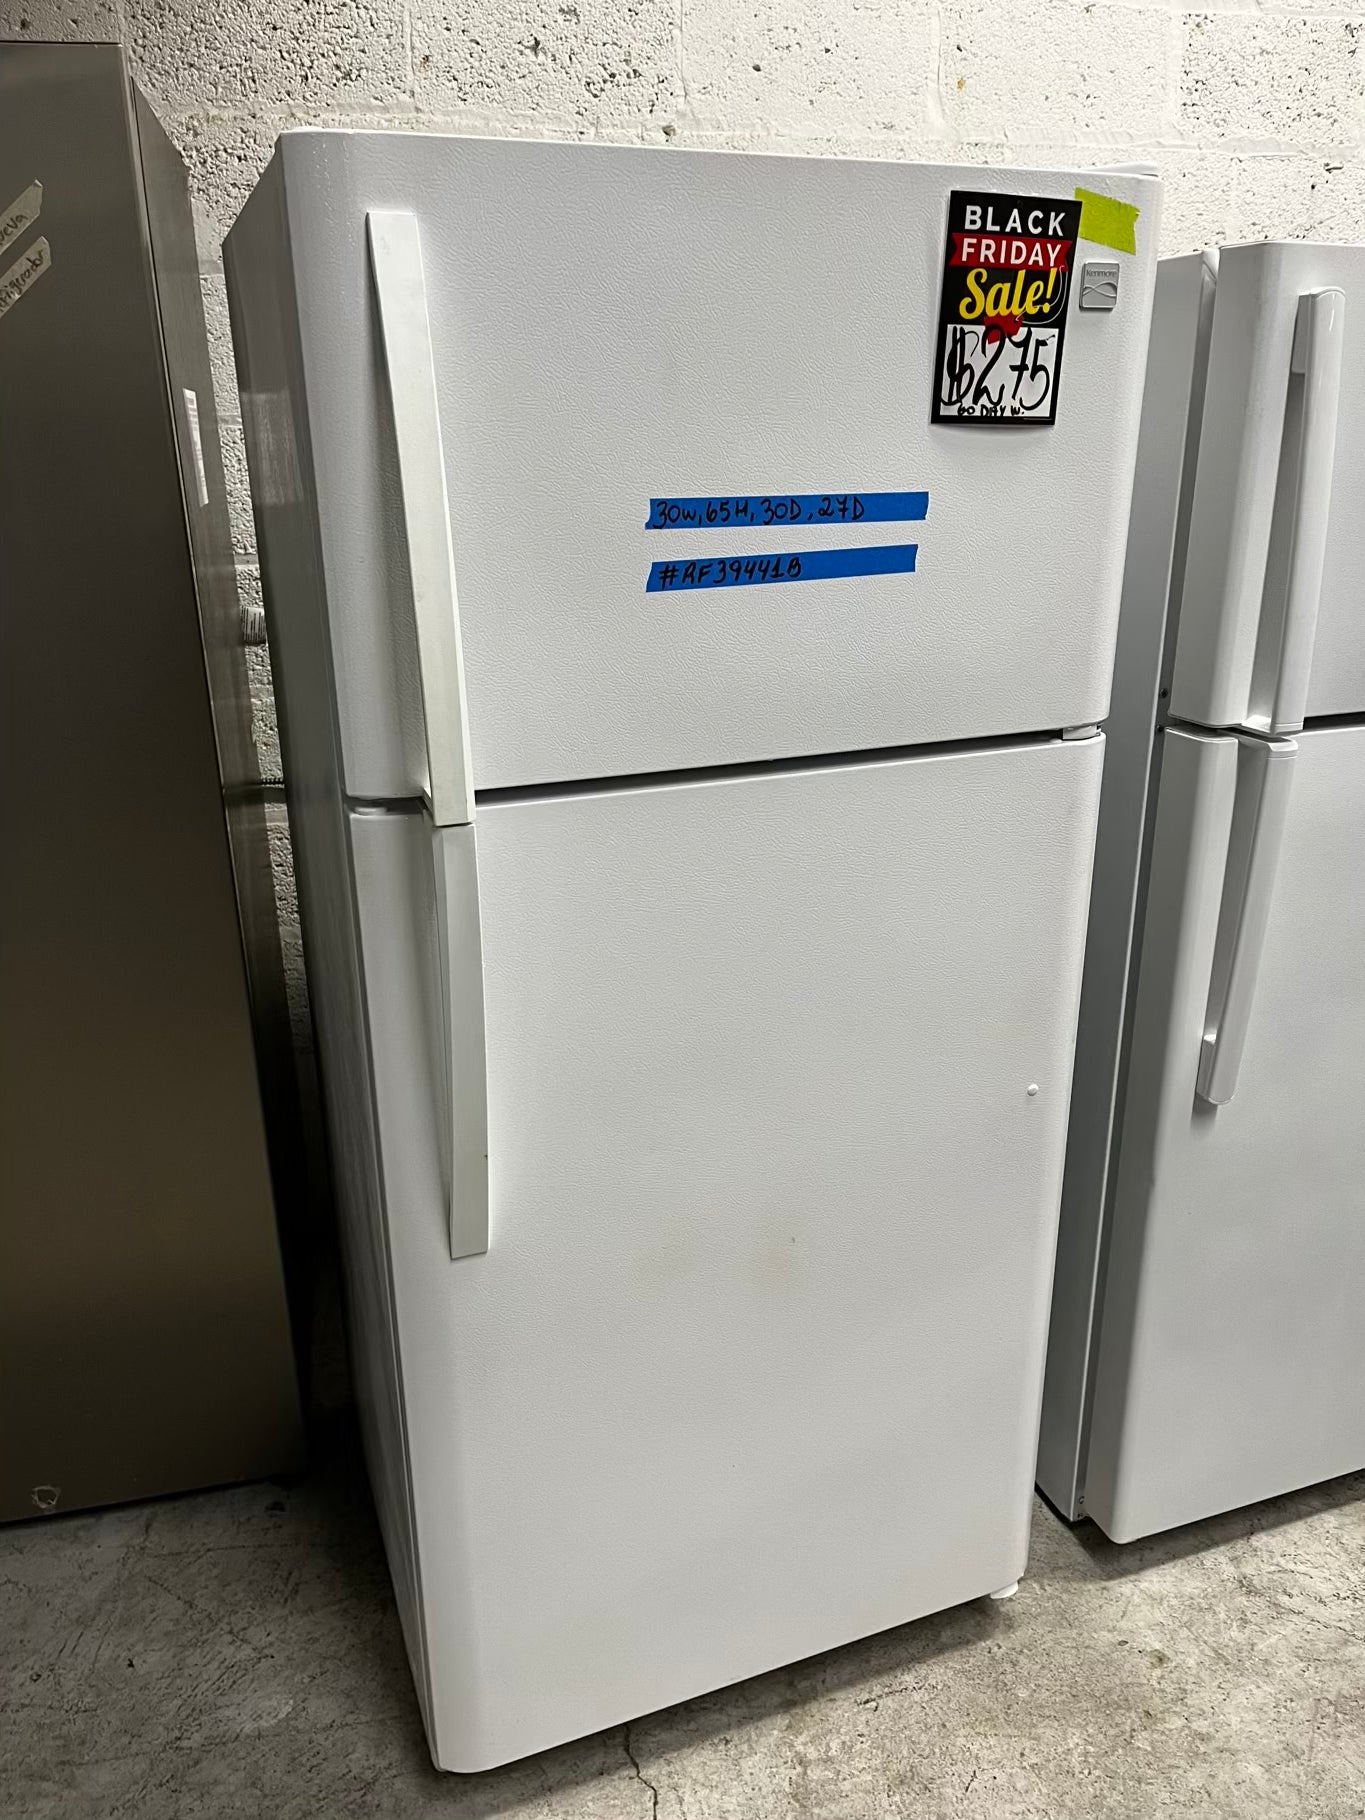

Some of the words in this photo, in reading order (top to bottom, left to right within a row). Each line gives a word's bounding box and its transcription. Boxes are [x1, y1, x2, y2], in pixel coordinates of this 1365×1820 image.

[964, 204, 1066, 237] BLACK
[961, 237, 1062, 267] FRIDAY
[1086, 269, 1118, 278] Kenmore
[958, 267, 1058, 320] Sale!
[940, 325, 1056, 411] $275
